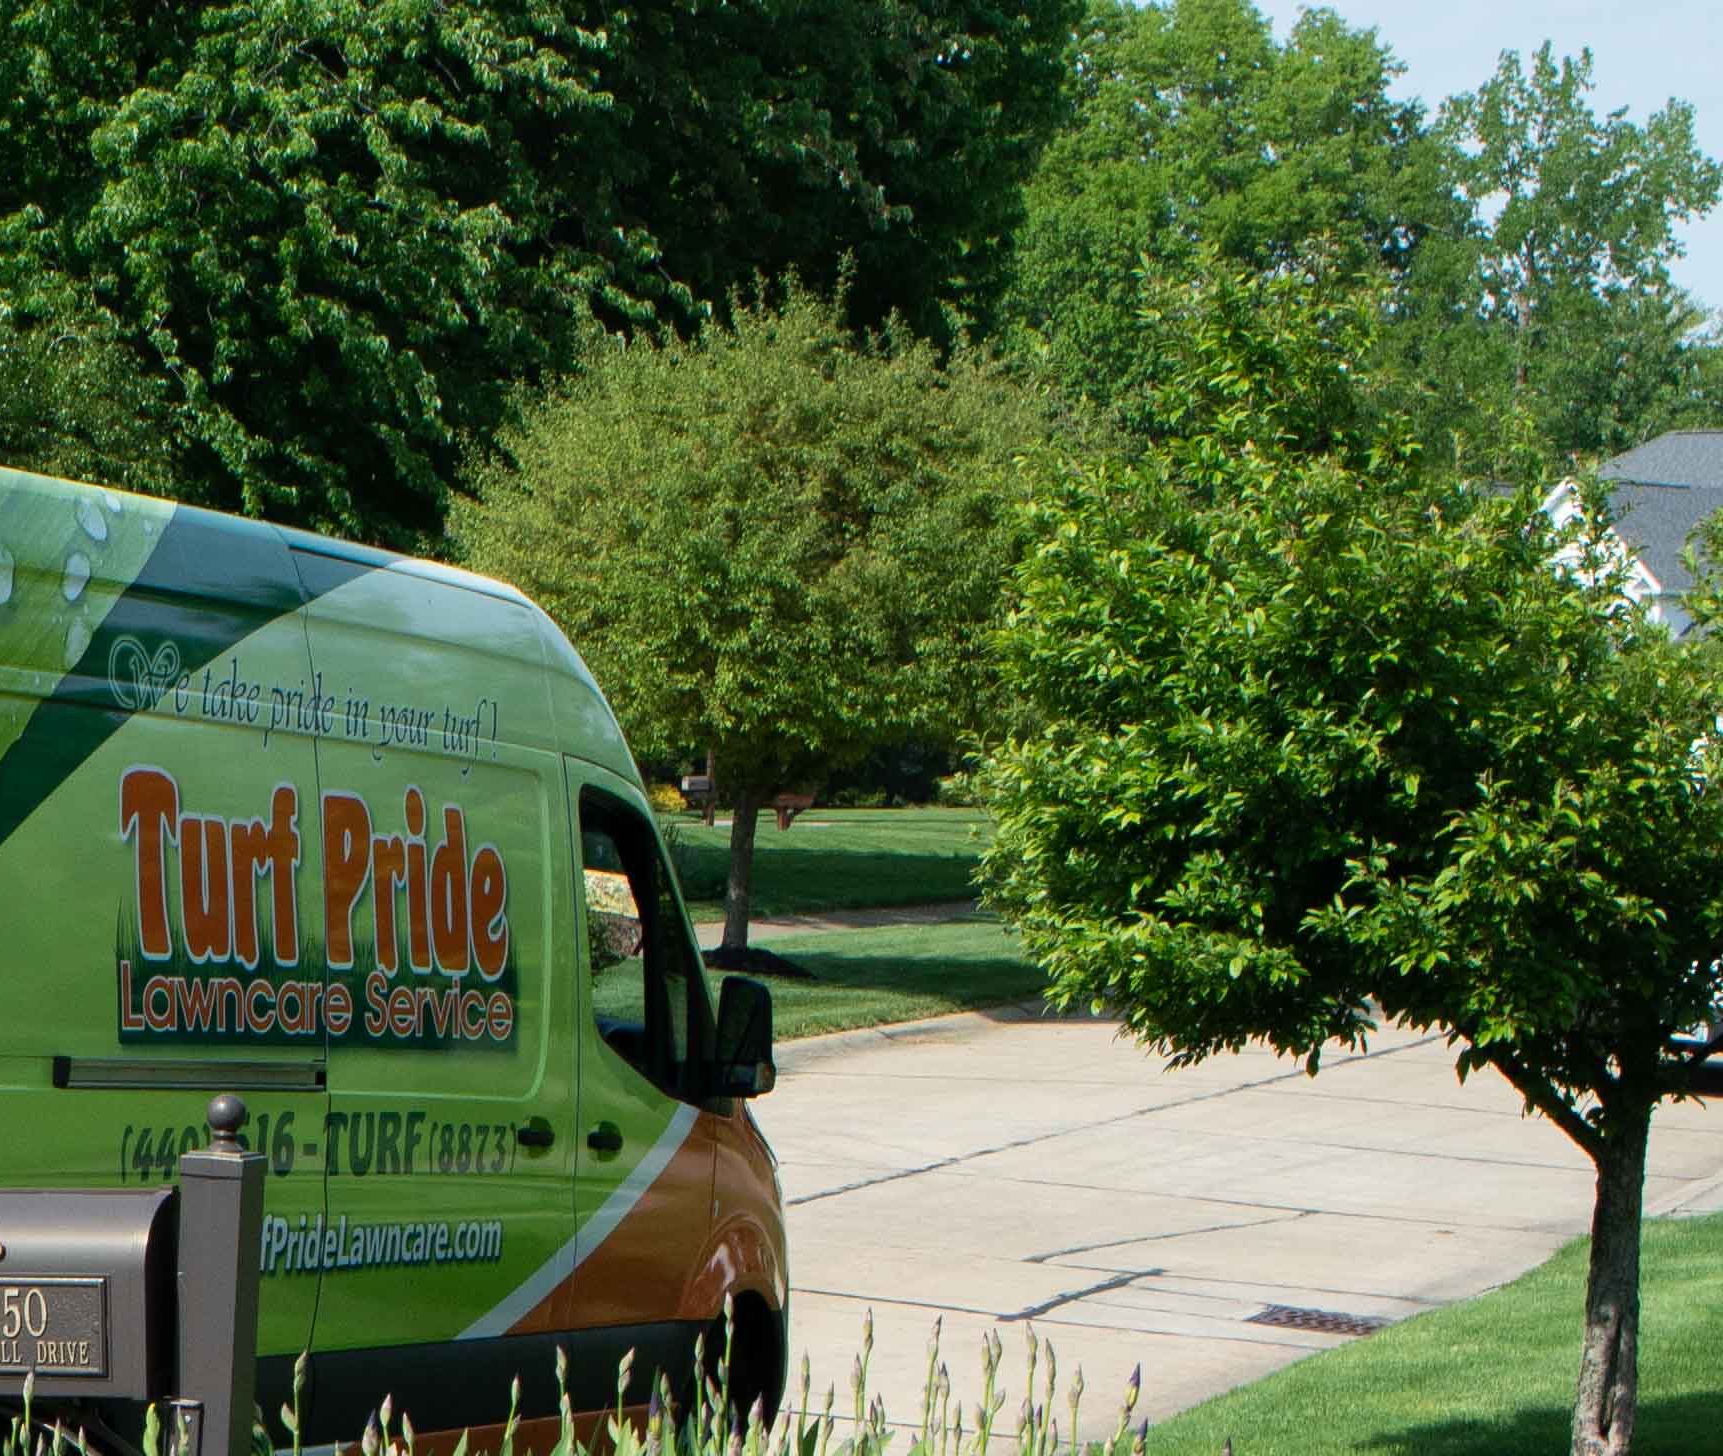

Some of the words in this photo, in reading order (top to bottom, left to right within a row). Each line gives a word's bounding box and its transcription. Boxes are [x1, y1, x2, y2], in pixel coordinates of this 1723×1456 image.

[108, 636, 190, 717] We
[202, 657, 260, 726] take
[263, 672, 334, 749] pride
[345, 687, 369, 739] in
[372, 703, 434, 761] your
[120, 764, 301, 970] Turf
[322, 784, 509, 982] Pride
[120, 960, 353, 1036] Lawncare
[365, 972, 514, 1041] Service
[36, 1341, 91, 1365] DRIVE
